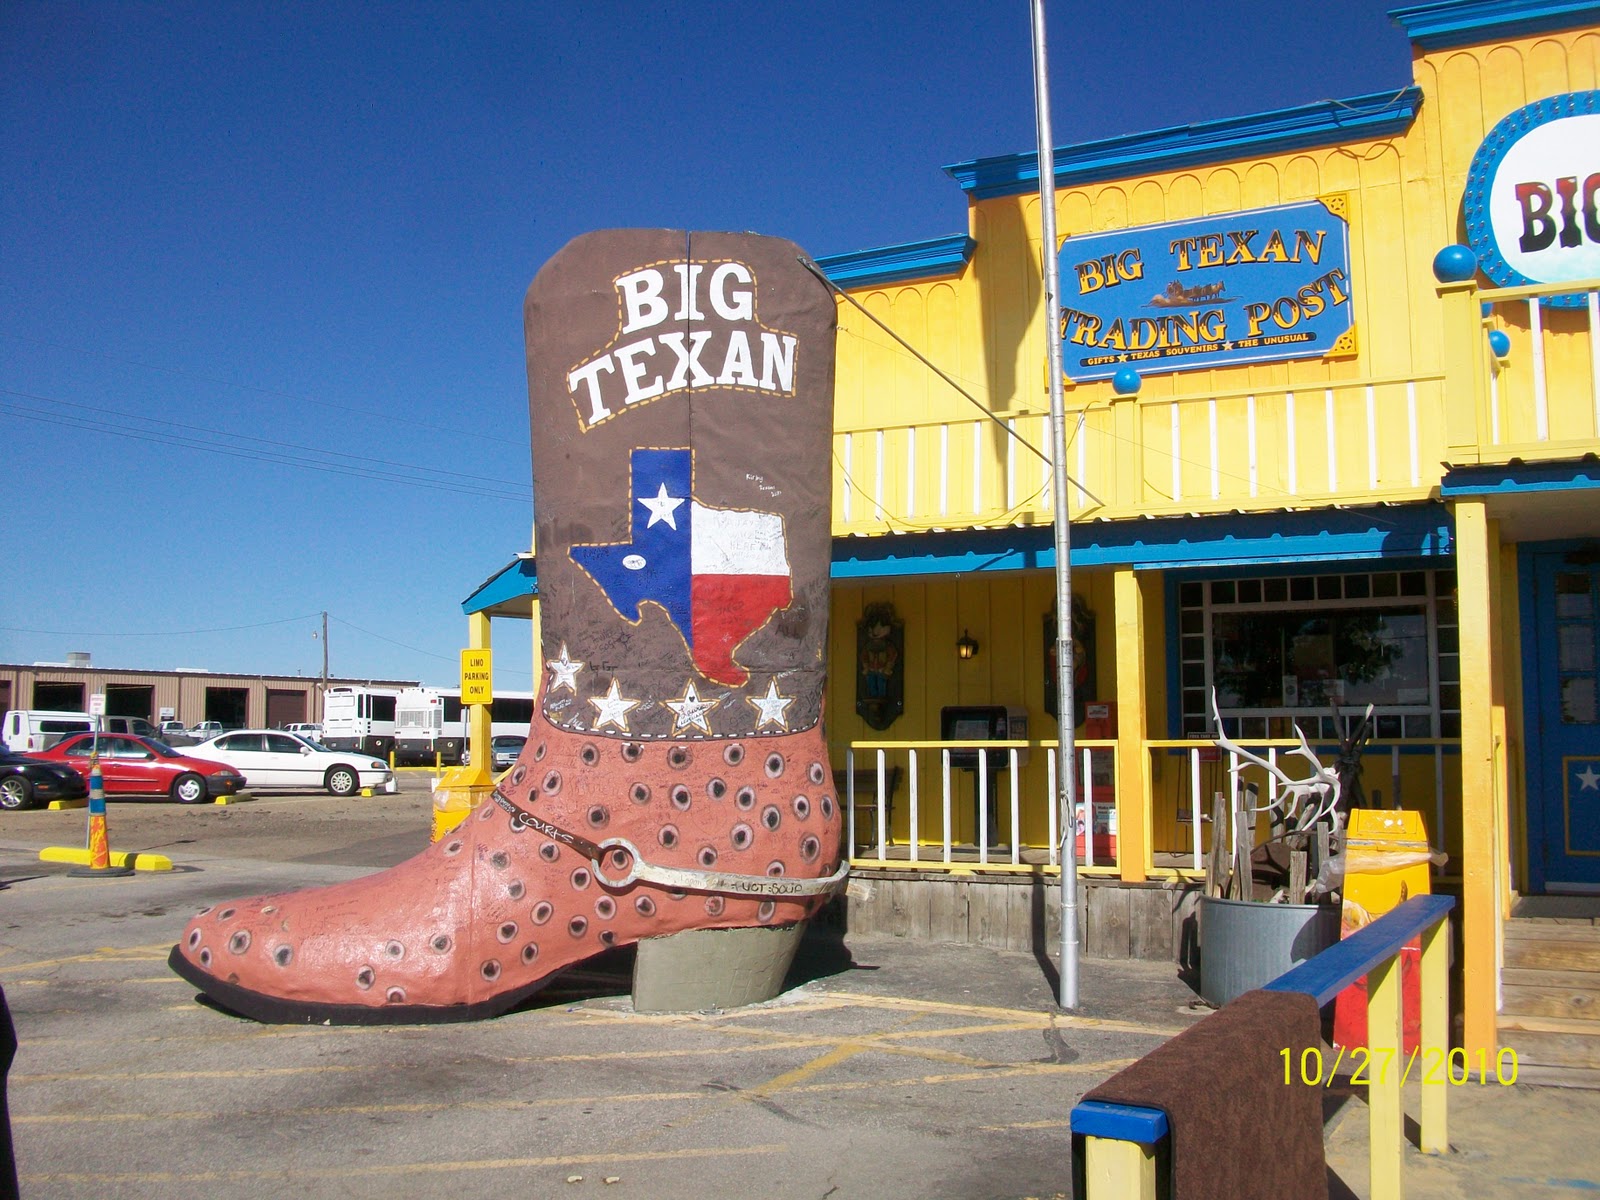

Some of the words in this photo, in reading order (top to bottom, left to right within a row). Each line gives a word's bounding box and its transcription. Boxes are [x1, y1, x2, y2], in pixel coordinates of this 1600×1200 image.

[1074, 248, 1145, 295] BIG
[1169, 229, 1327, 272] TEXAN
[616, 262, 753, 335] BIG
[1243, 267, 1349, 338] POST
[1087, 355, 1115, 366] GIFTS
[1130, 350, 1160, 360] TEXAS
[1165, 343, 1218, 356] SOUVENIRS
[1238, 338, 1258, 348] THE
[1264, 333, 1308, 345] UNUSUAL
[568, 330, 797, 425] TEXAN
[464, 672, 489, 681] PARKING
[470, 658, 484, 667] LIMO
[469, 686, 484, 695] ONLY
